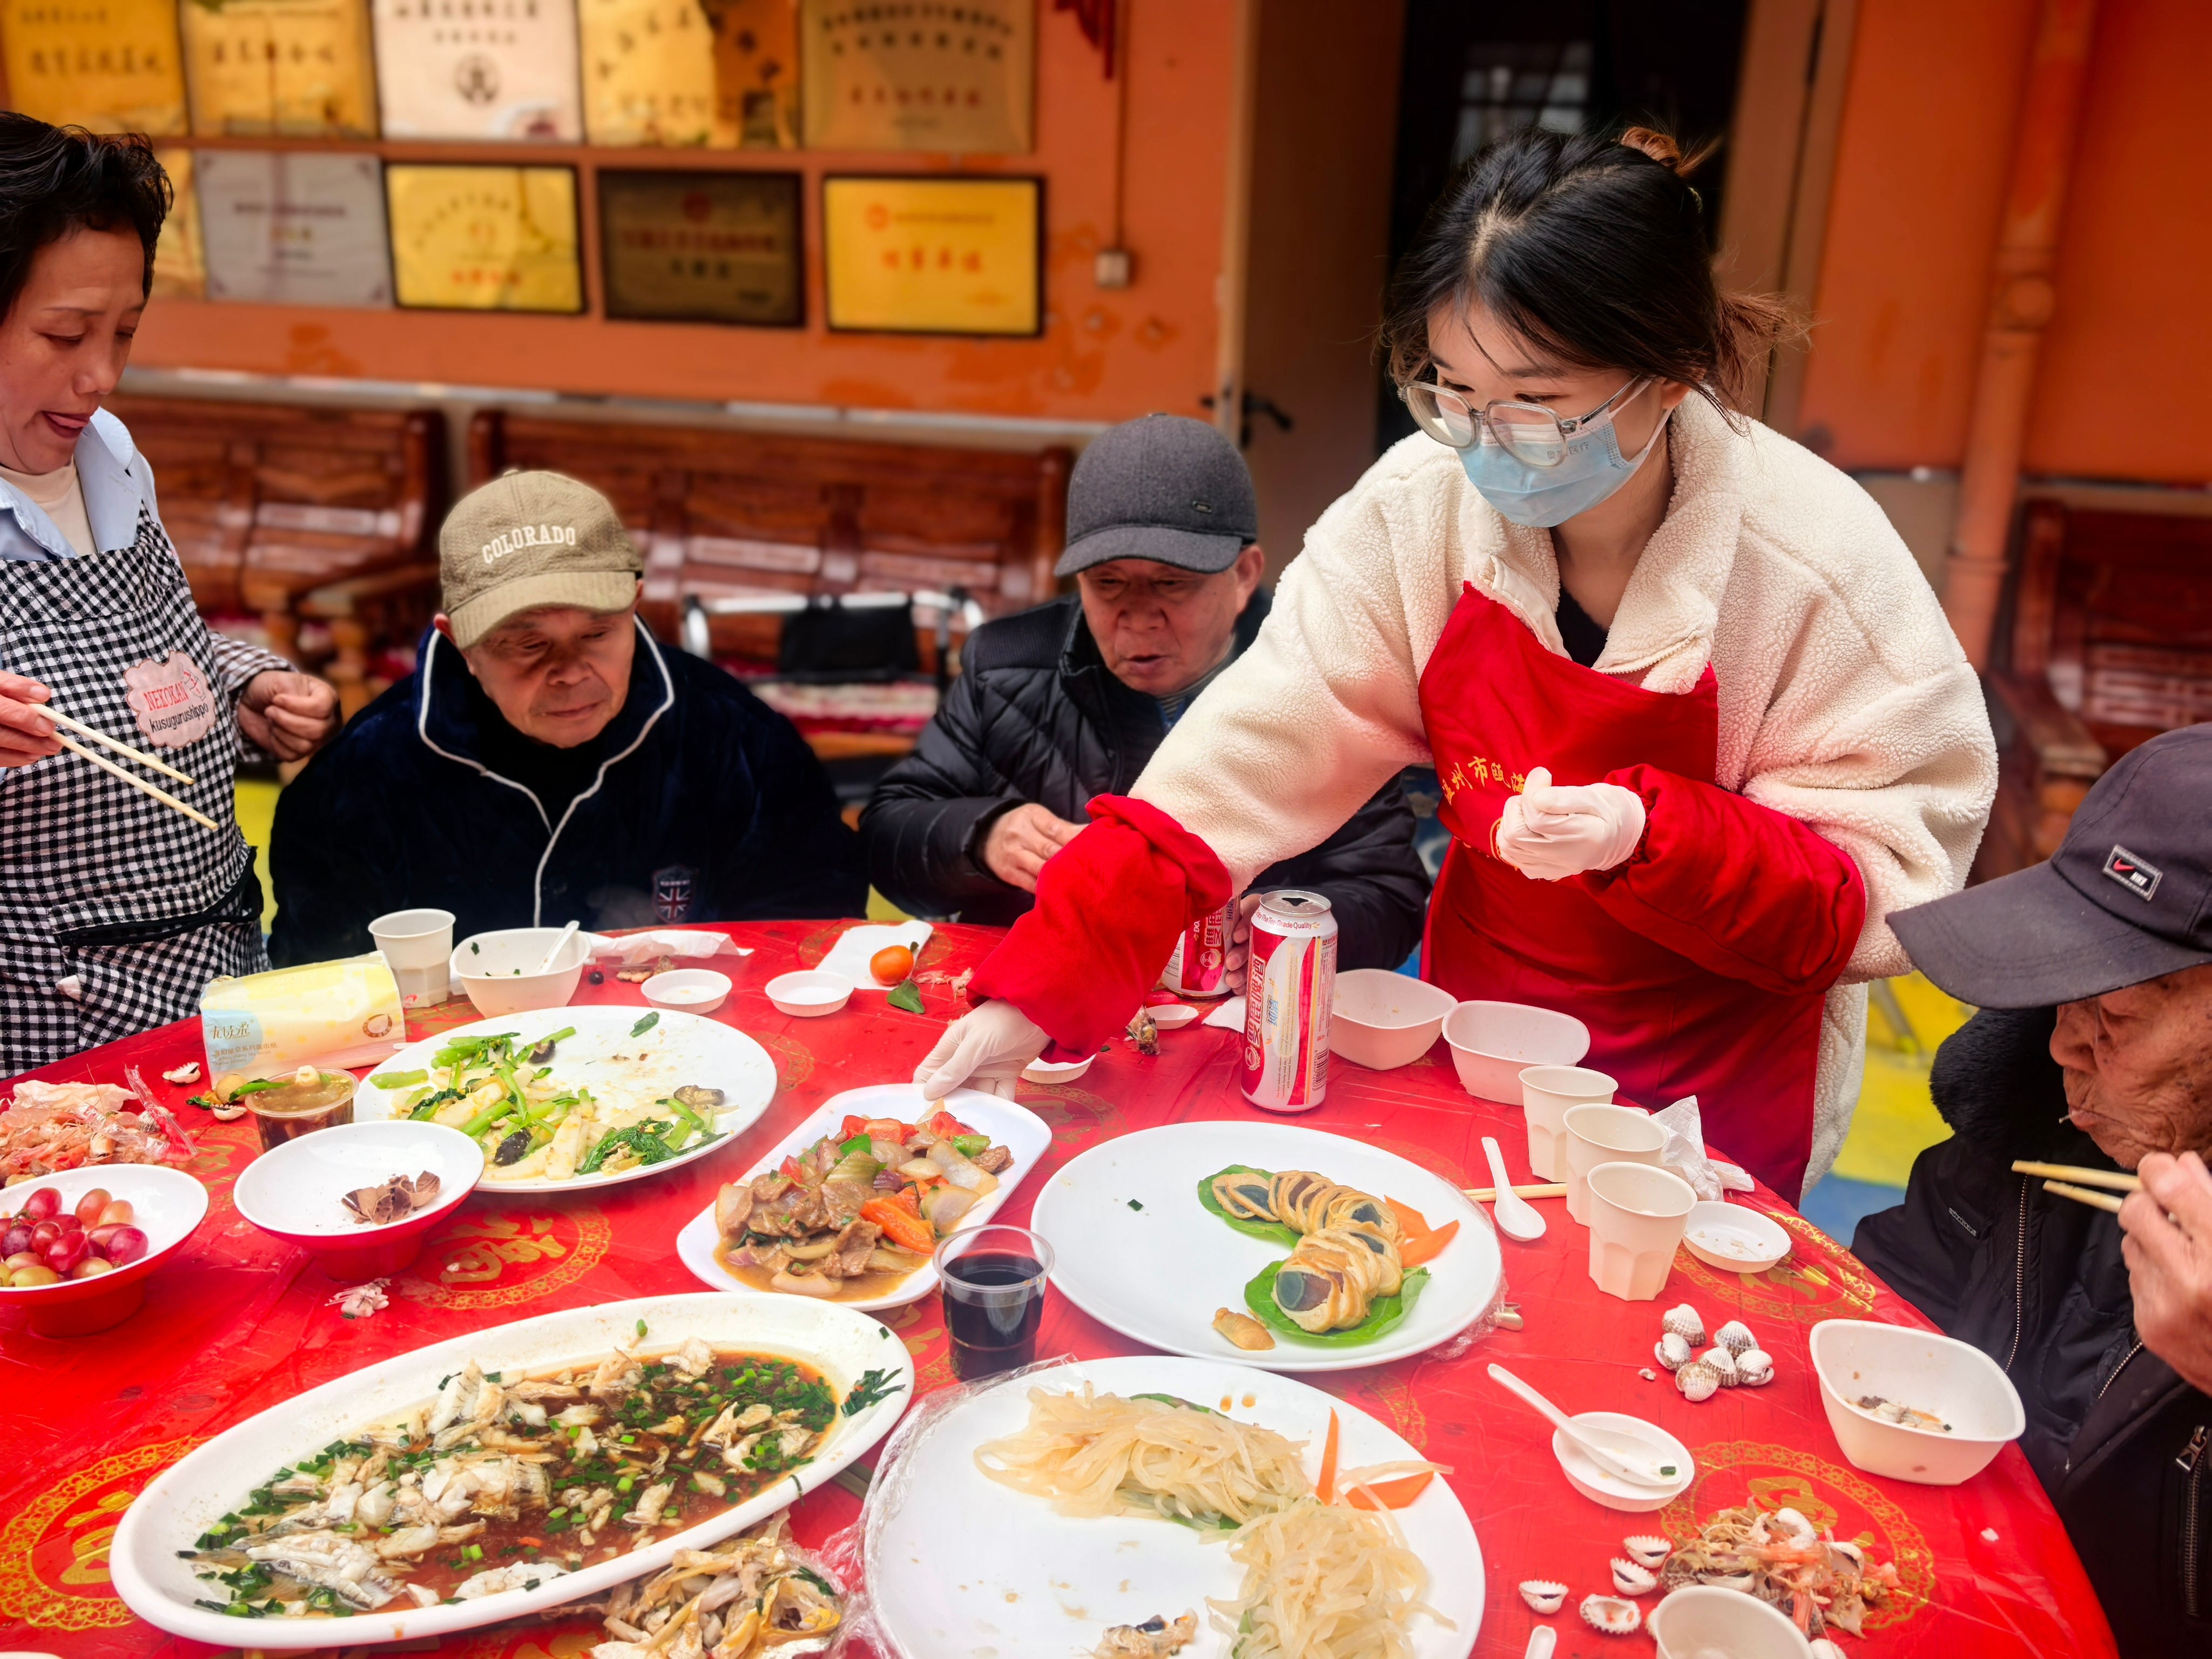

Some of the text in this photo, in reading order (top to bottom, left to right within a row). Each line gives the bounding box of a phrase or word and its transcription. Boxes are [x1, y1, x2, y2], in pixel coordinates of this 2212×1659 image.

[482, 524, 576, 564] COLORADO
[143, 681, 188, 711] NEKOKAN
[149, 702, 209, 733] kusugurushippo
[1277, 920, 1293, 928] Grade
[1293, 921, 1312, 929] Quality
